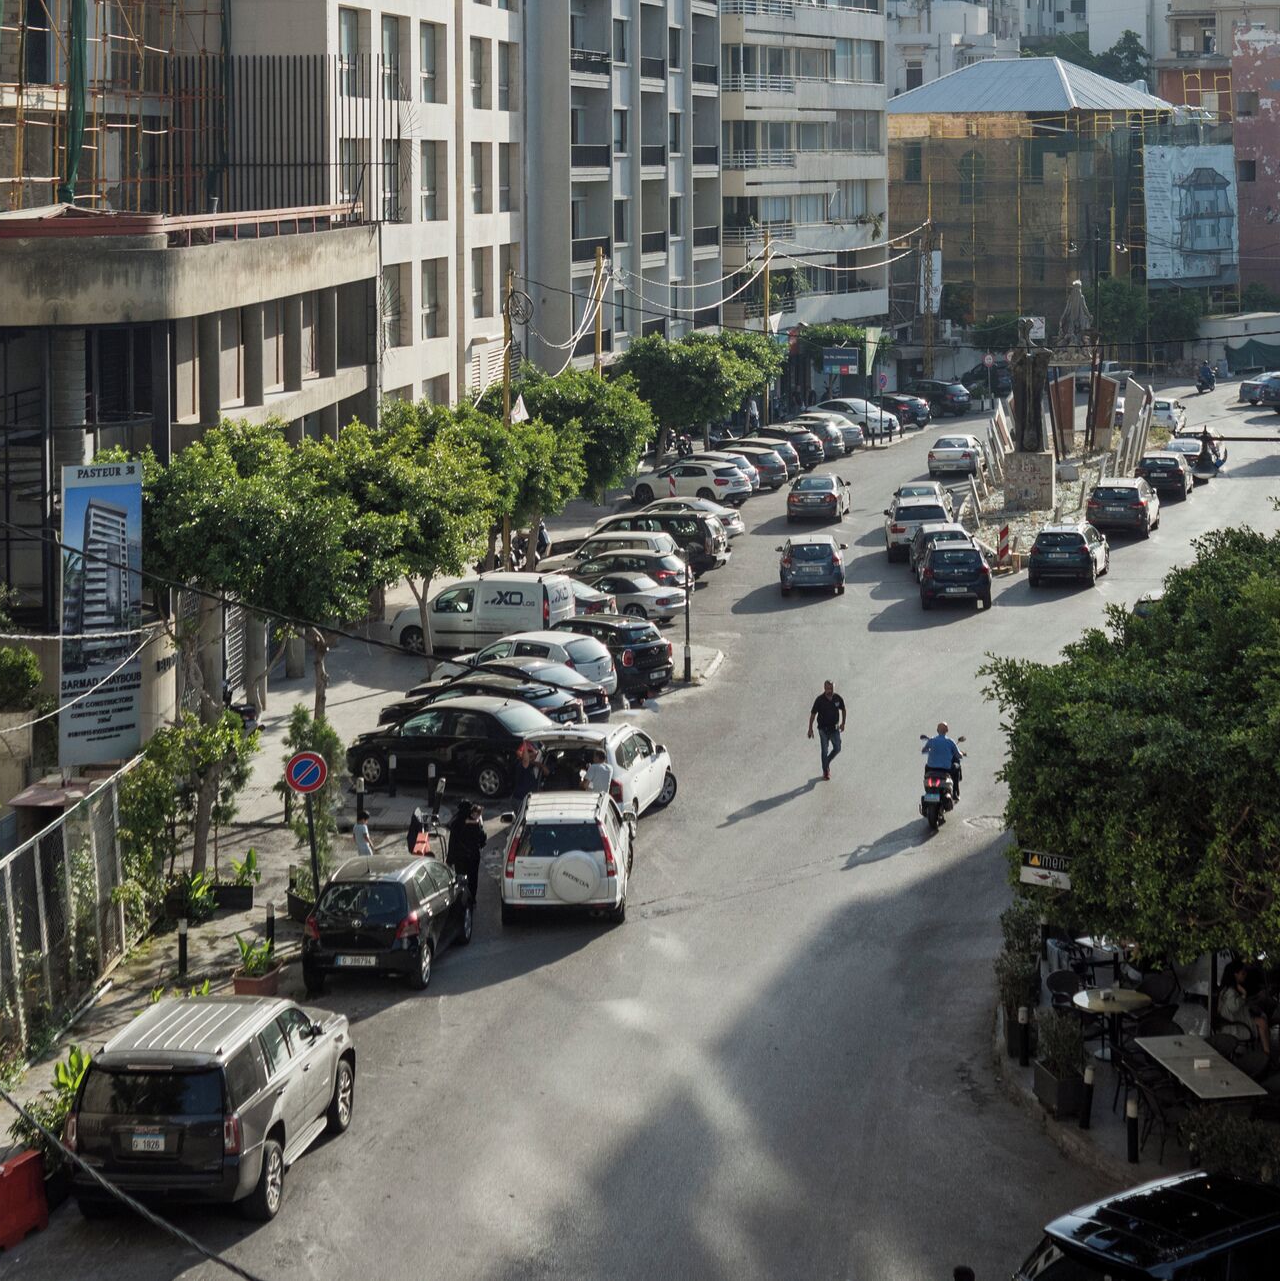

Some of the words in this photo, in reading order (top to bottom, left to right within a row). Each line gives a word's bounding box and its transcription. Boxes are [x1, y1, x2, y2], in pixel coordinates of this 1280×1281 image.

[77, 467, 121, 479] PASTEUR
[61, 677, 98, 691] SARMAD
[562, 870, 590, 889] HONDA
